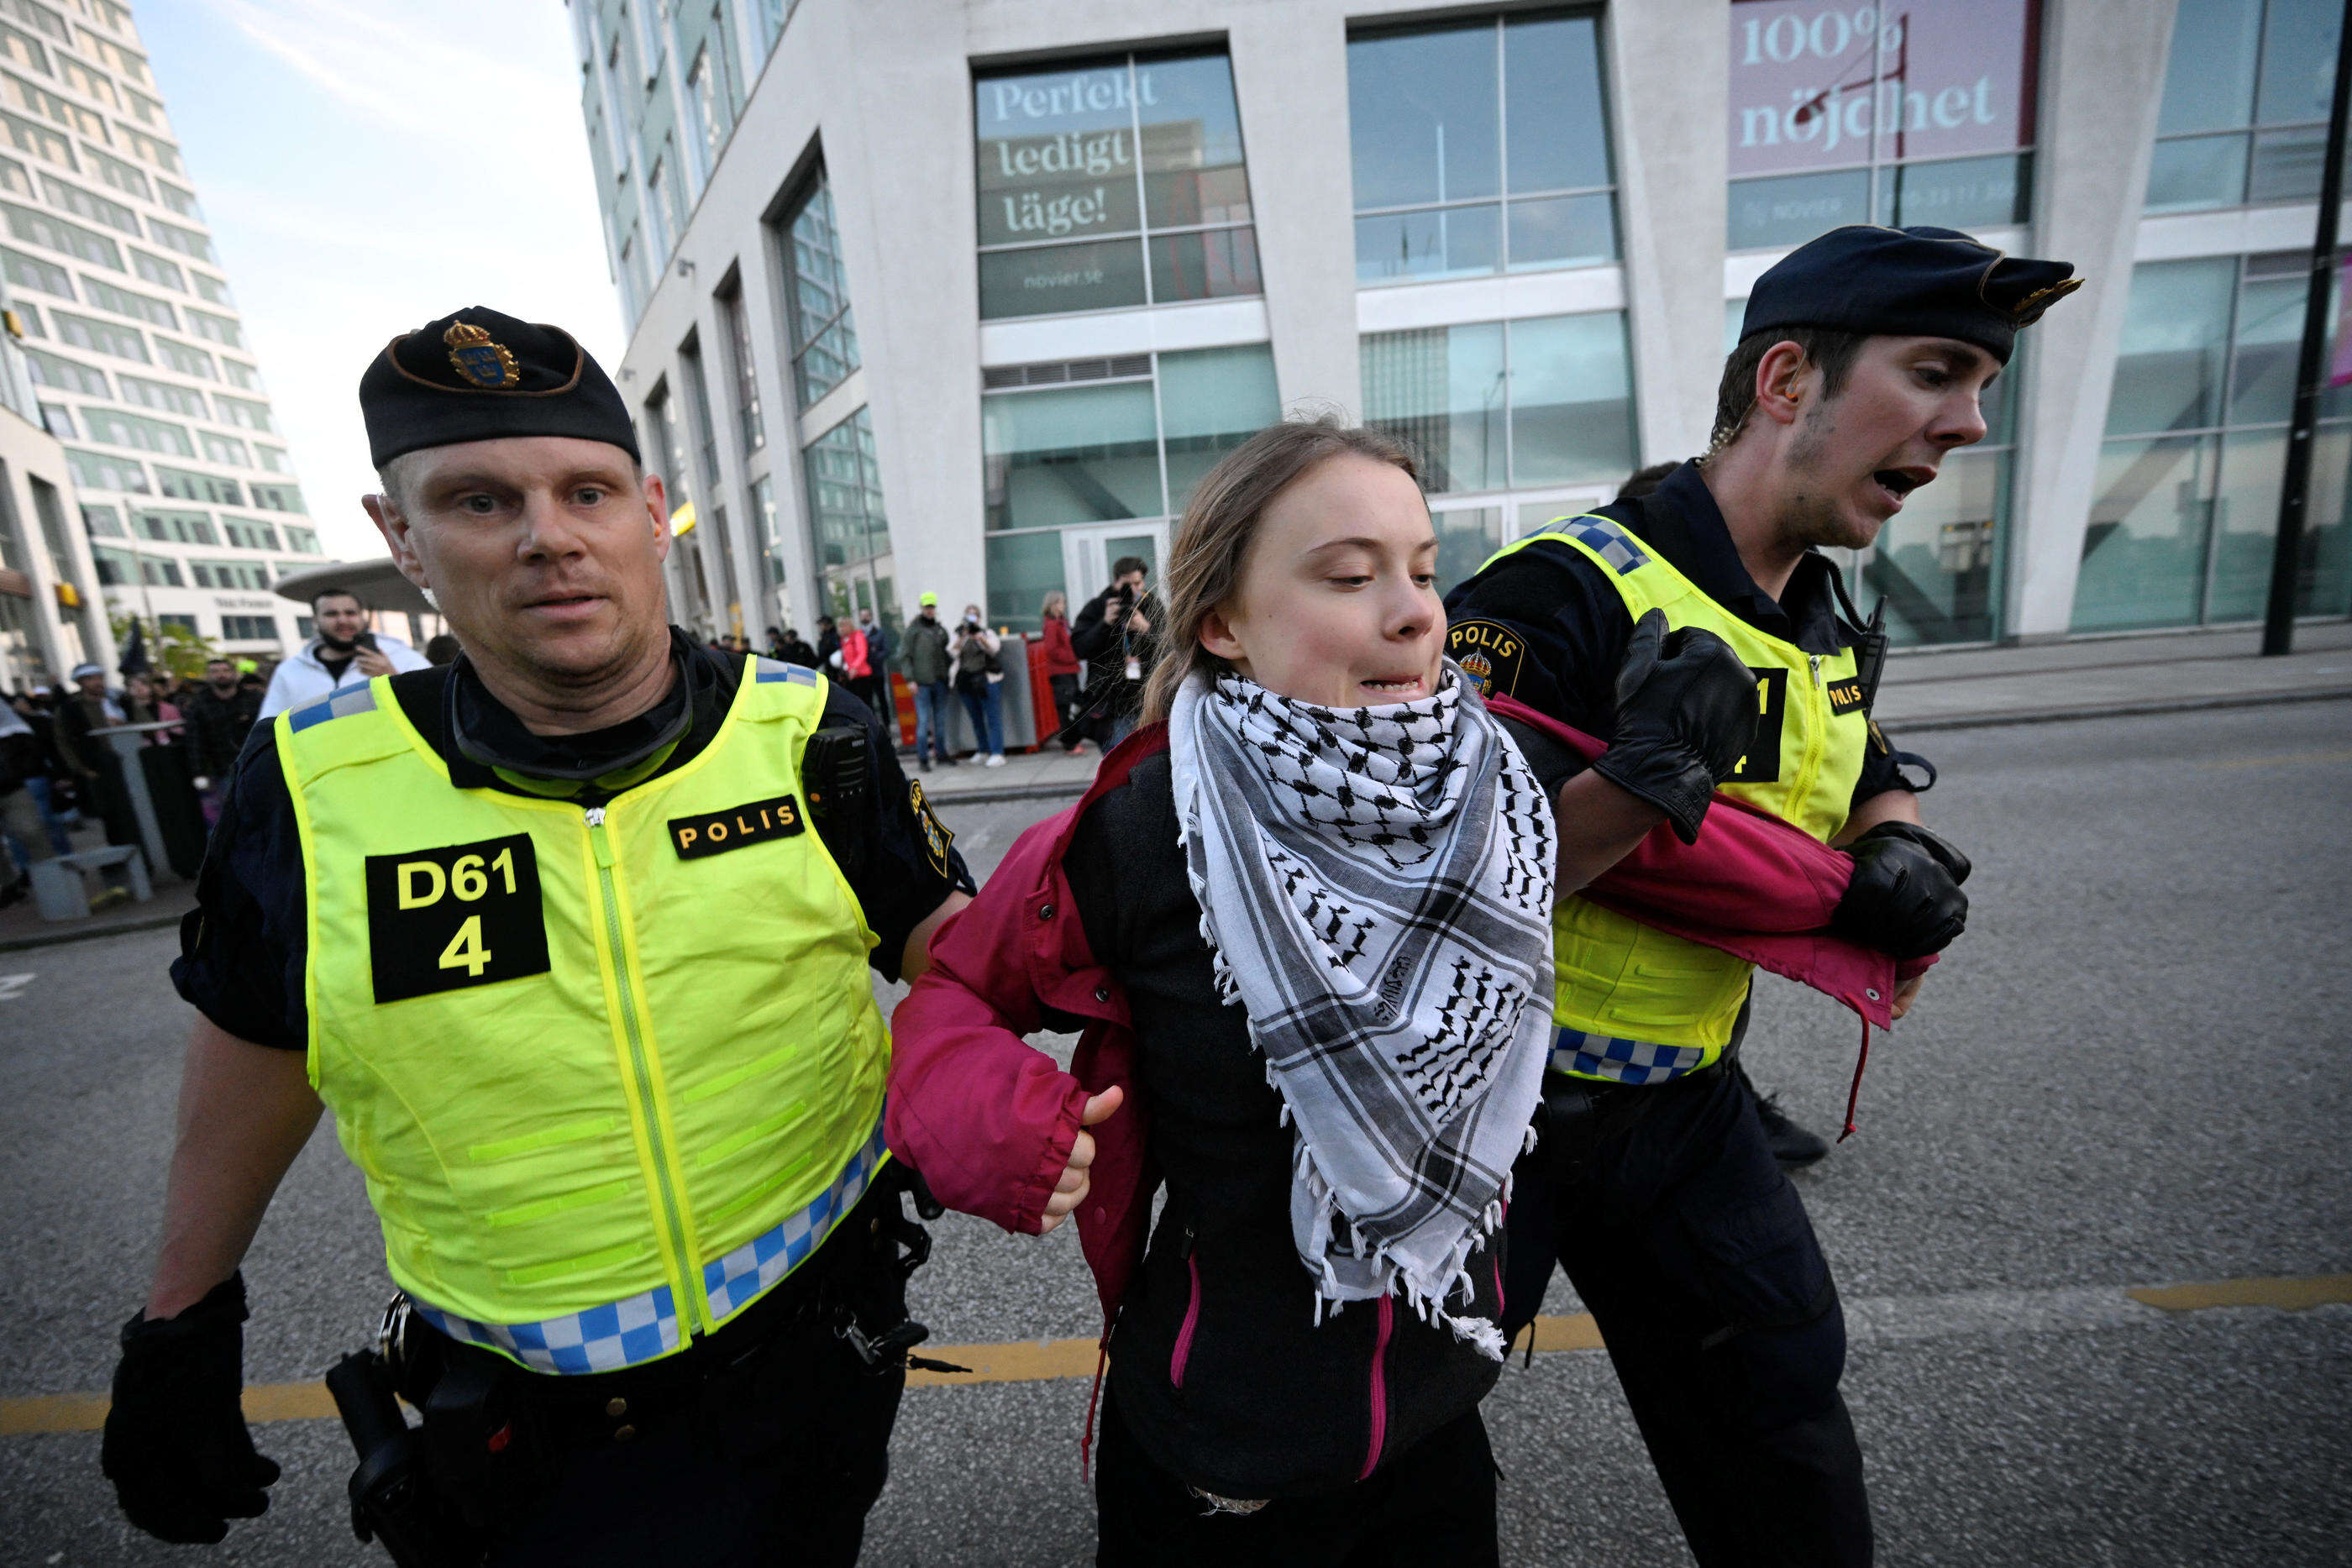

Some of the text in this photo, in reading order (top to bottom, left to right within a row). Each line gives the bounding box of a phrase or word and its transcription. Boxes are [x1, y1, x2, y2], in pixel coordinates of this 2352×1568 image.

[1740, 6, 1903, 66] 100%
[993, 71, 1158, 121] Perfekt
[997, 131, 1131, 176] ledigt
[1002, 186, 1107, 236] läge!
[1452, 627, 1517, 657] POLIS
[678, 804, 795, 849] POLIS
[397, 847, 517, 911] D61
[438, 914, 491, 977] 4
